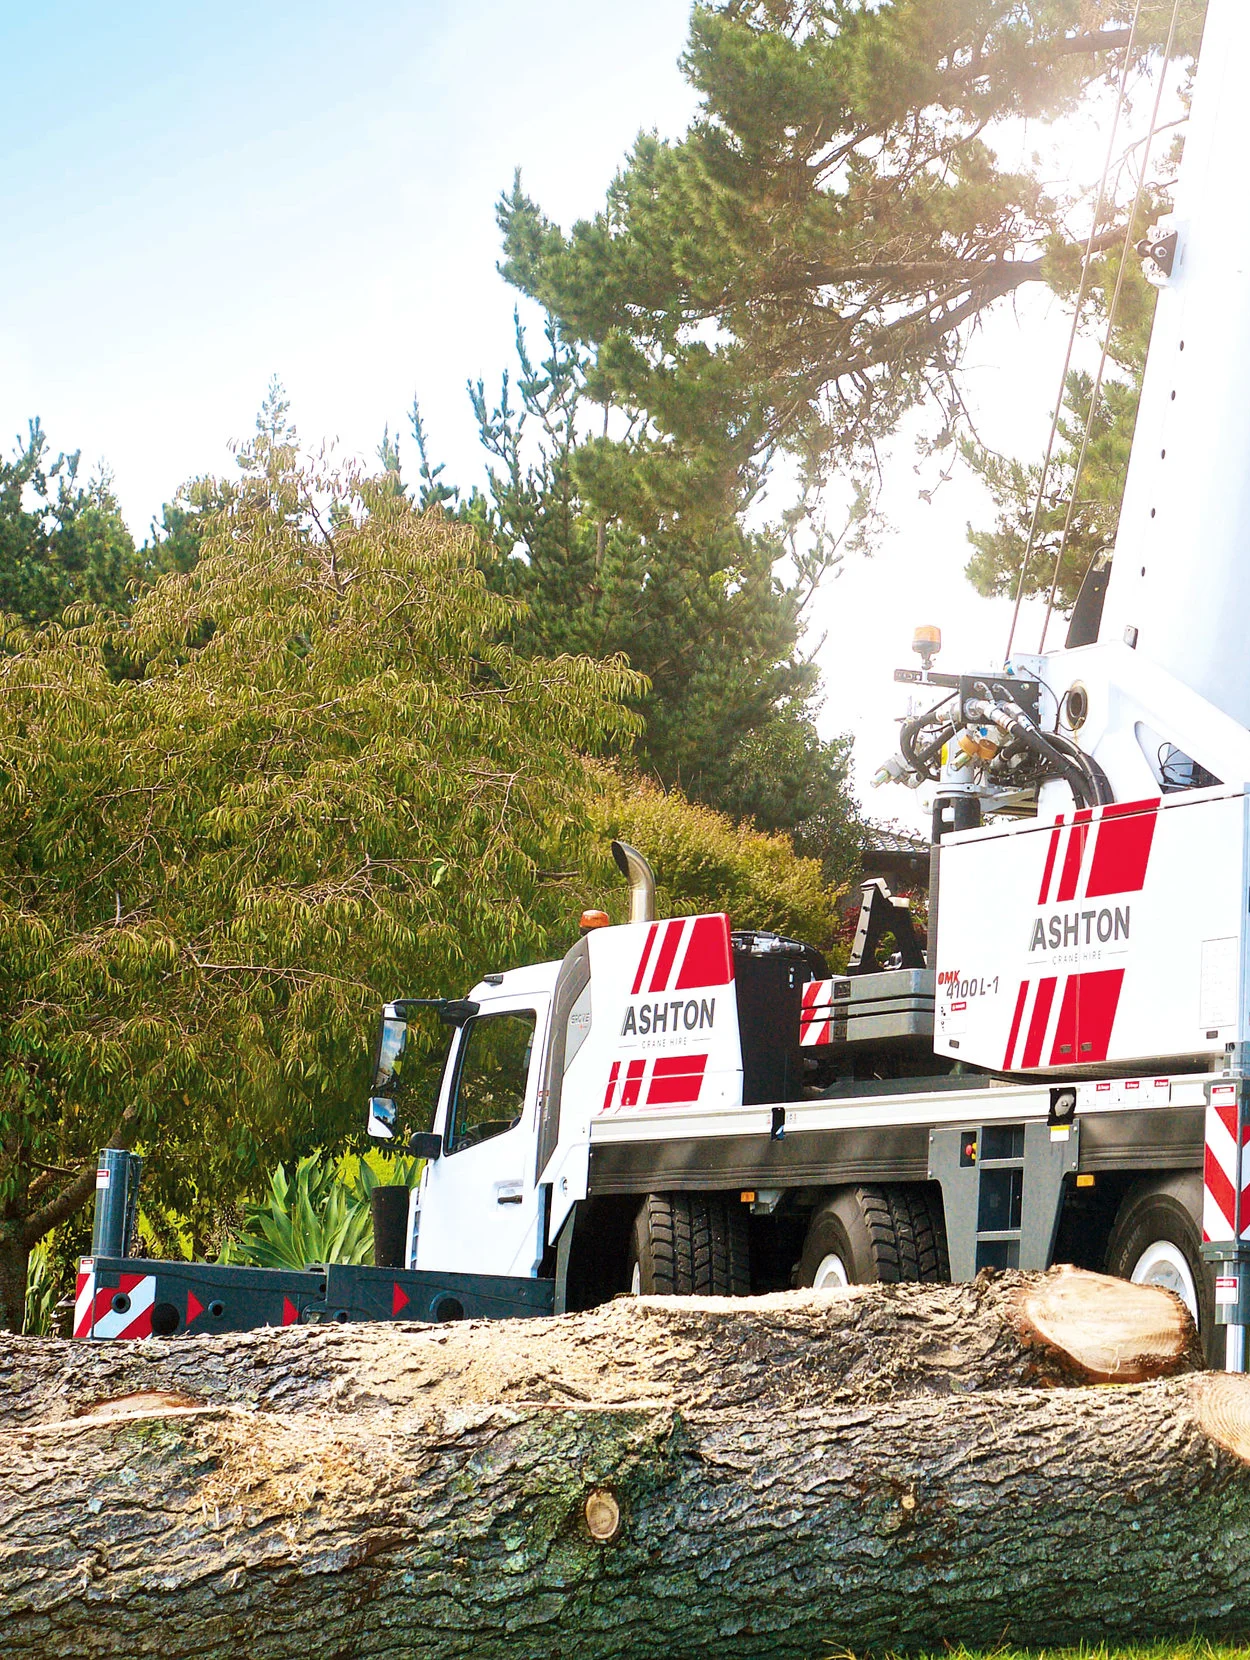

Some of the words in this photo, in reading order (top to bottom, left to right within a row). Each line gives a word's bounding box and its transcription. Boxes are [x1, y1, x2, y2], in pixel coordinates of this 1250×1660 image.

[1029, 906, 1130, 951] ASHTON
[1052, 953, 1078, 965] CRANE
[1083, 950, 1101, 960] HIRE
[621, 998, 715, 1036] ASHTON
[642, 1039, 666, 1048] CRANE
[670, 1036, 687, 1045] HIRE
